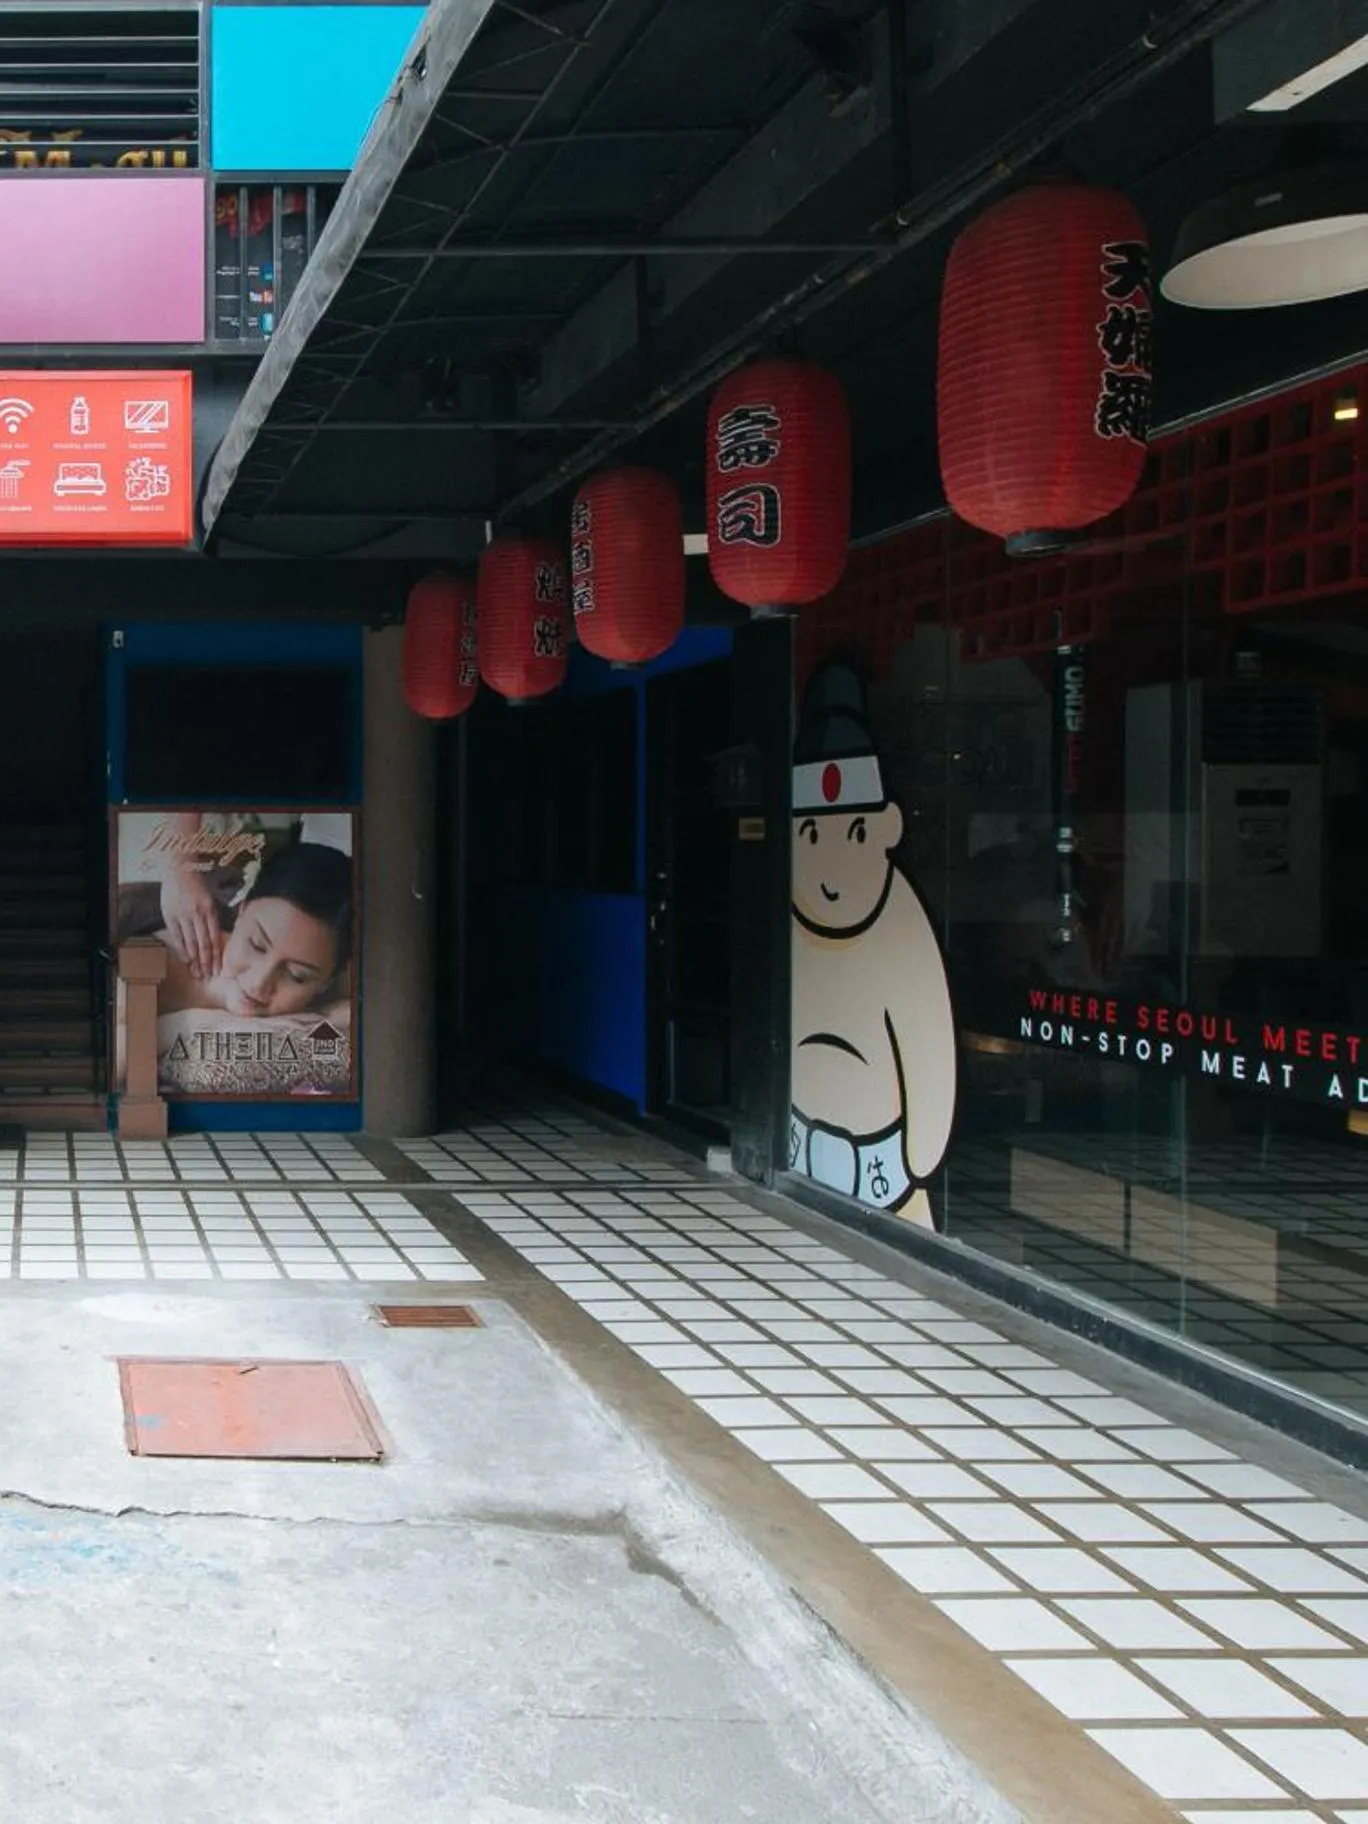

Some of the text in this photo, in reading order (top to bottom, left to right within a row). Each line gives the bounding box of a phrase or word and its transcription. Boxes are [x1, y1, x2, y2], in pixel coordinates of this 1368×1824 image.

[1020, 1016, 1174, 1064] NON-STOP
[1201, 1049, 1294, 1088] MEAT
[1029, 989, 1361, 1063] WHERE SEOUL MEET
